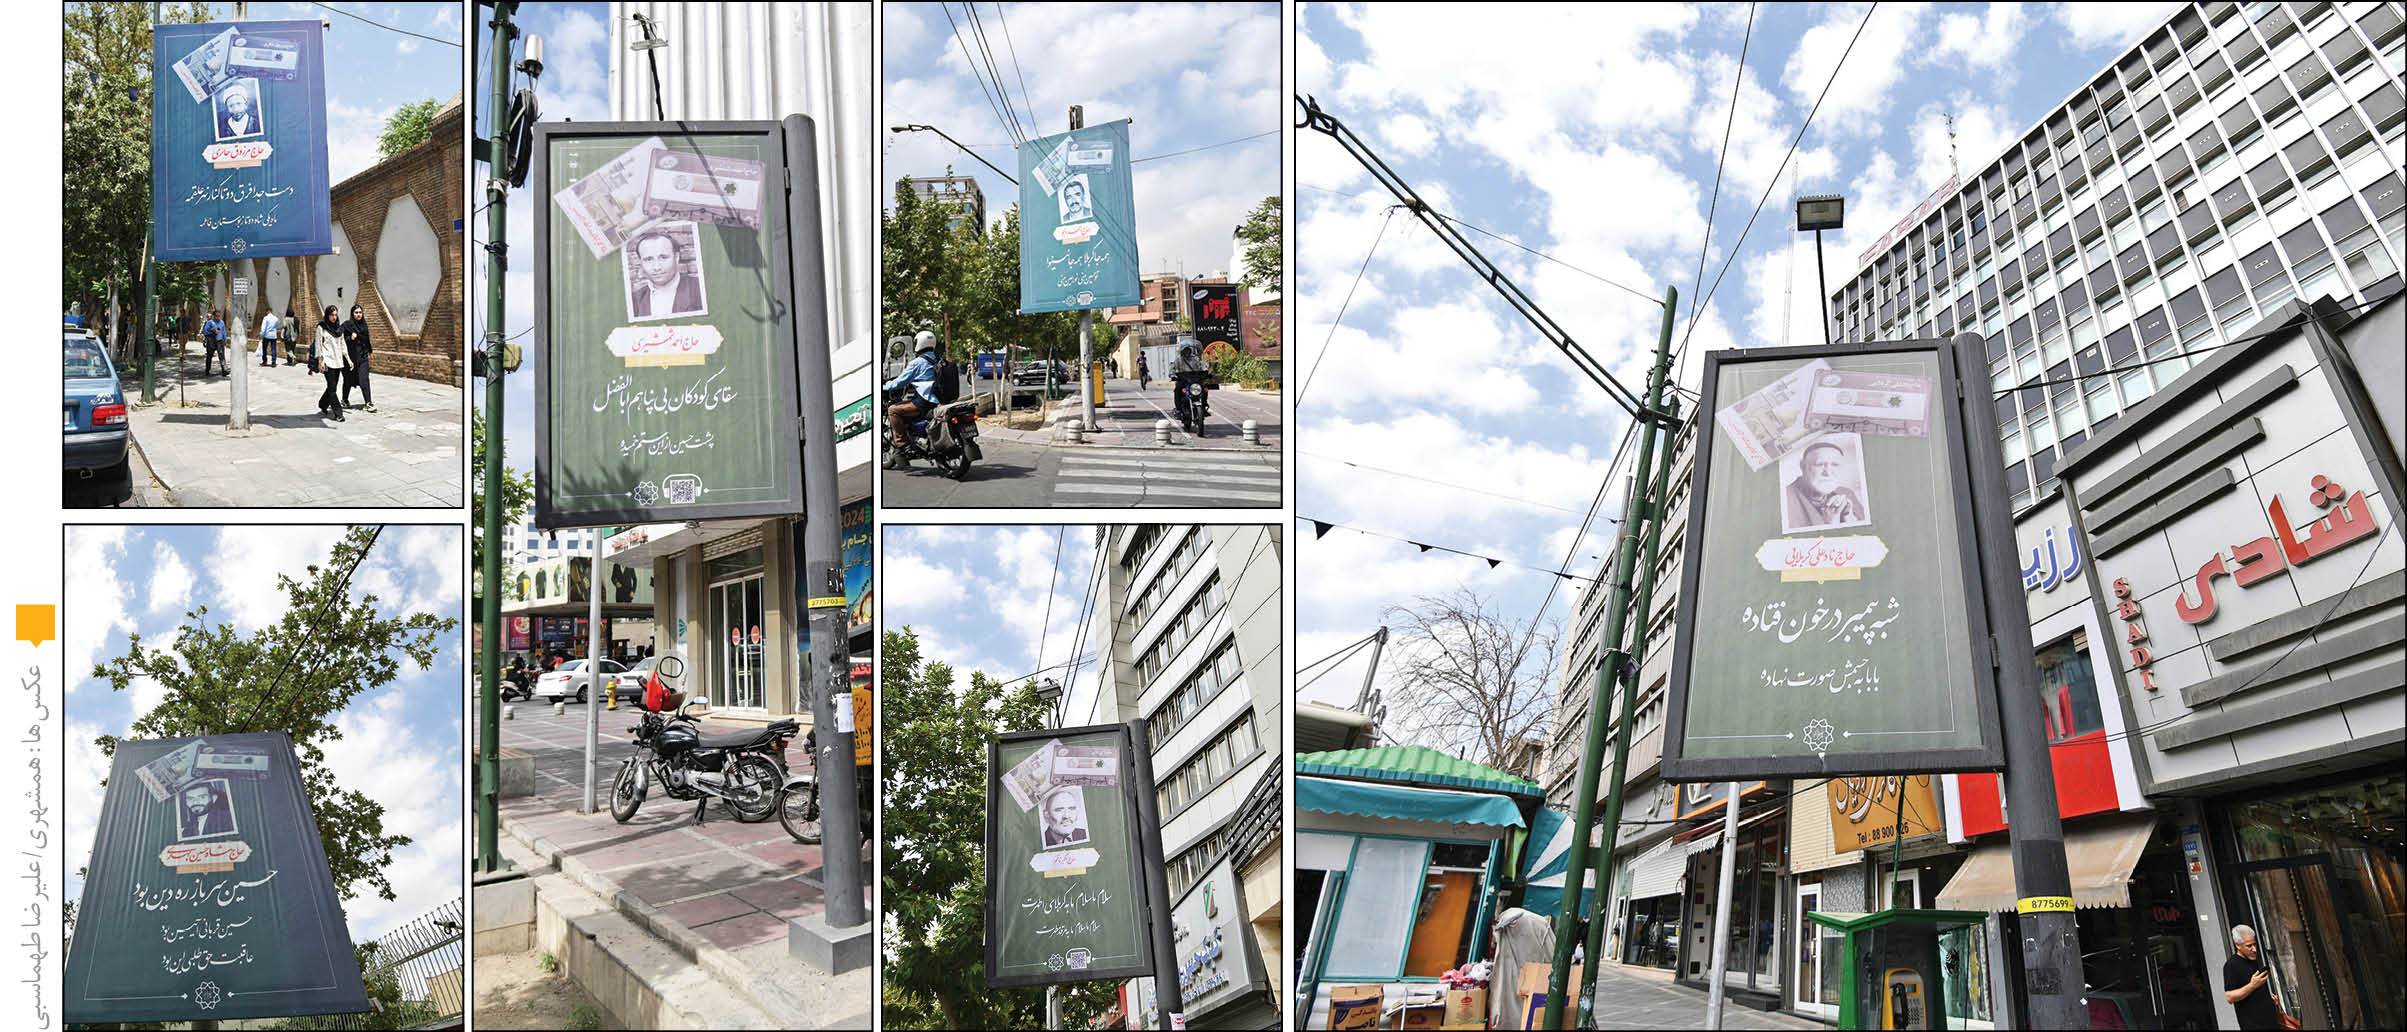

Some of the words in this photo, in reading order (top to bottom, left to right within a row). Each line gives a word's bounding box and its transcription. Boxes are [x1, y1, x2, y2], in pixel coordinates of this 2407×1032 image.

[250, 146, 264, 159] حاج
[265, 185, 294, 197] دست
[682, 337, 699, 351] حاج
[668, 366, 726, 412] کودکان
[669, 434, 694, 455] حسین
[686, 431, 715, 449] پشت
[840, 505, 865, 529] 024
[1834, 549, 1856, 567] حاج
[2175, 474, 2380, 624] شادی
[1742, 601, 1786, 632] فتاده
[1778, 597, 1830, 644] خون
[2112, 576, 2159, 692] SHADI
[1760, 668, 1789, 688] نهاده
[1787, 668, 1836, 687] صورت
[132, 882, 150, 908] بود
[145, 887, 173, 911] دین
[217, 869, 279, 907] حسین
[1076, 892, 1092, 913] سلام
[1097, 888, 1113, 911] سلام
[2031, 899, 2069, 909] 8775699
[217, 915, 253, 938] حسین
[210, 943, 254, 965] عاقبت
